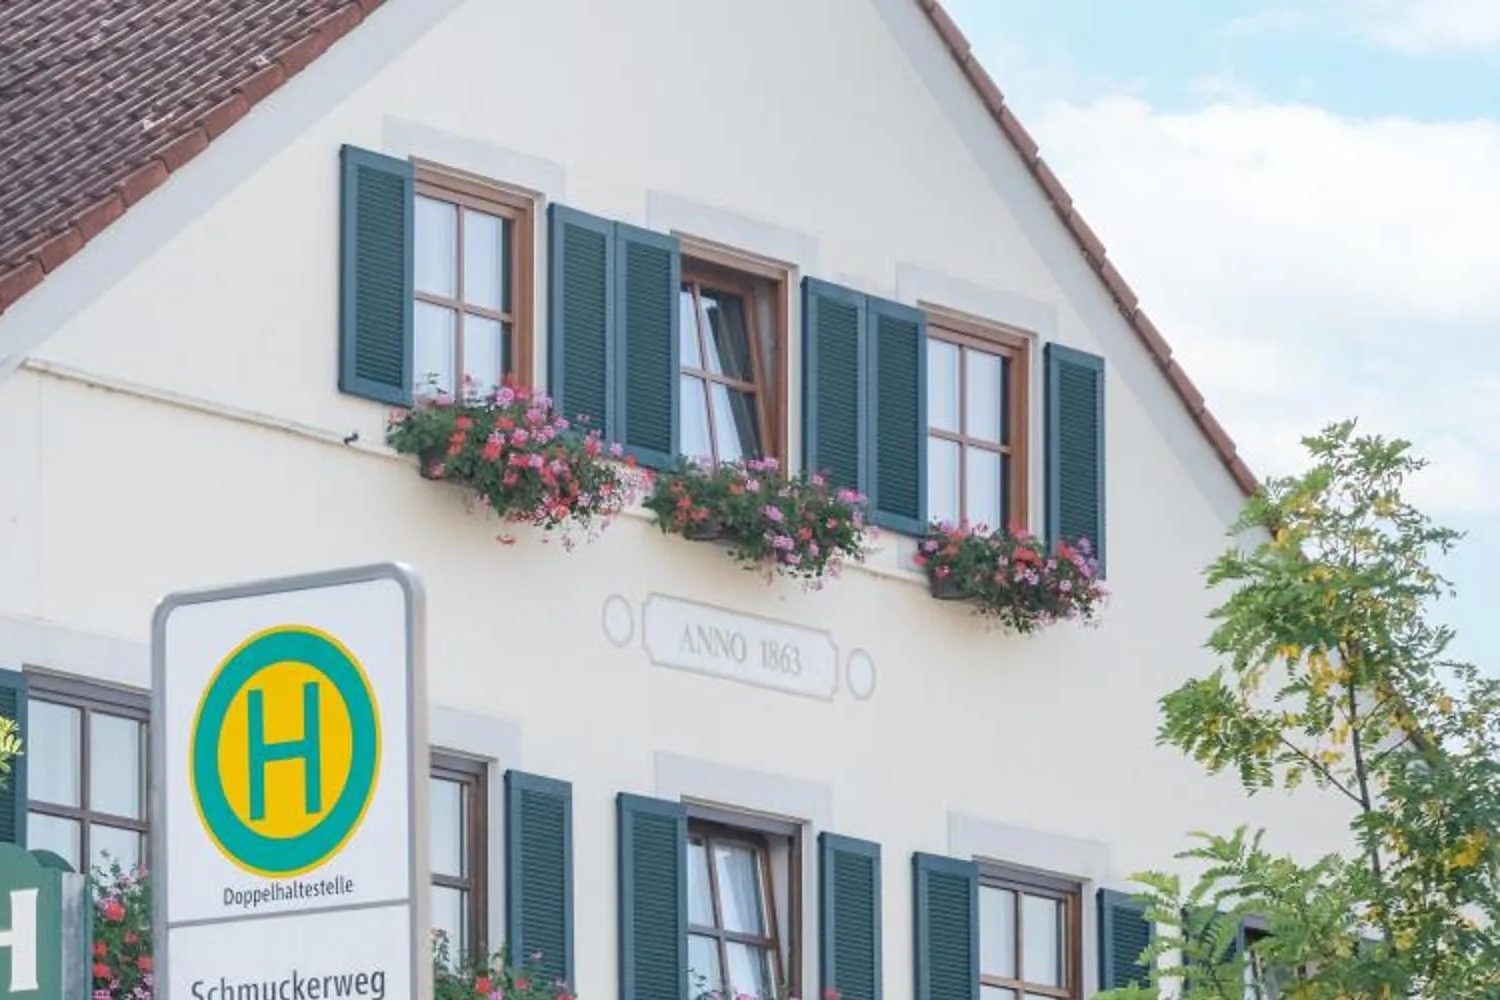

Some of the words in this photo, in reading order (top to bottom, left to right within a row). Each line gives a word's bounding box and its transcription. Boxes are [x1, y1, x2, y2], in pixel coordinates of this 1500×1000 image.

[680, 624, 747, 663] ANNO
[761, 640, 802, 676] 1863
[247, 681, 322, 822] H
[223, 874, 354, 908] Doppelhaltestelle
